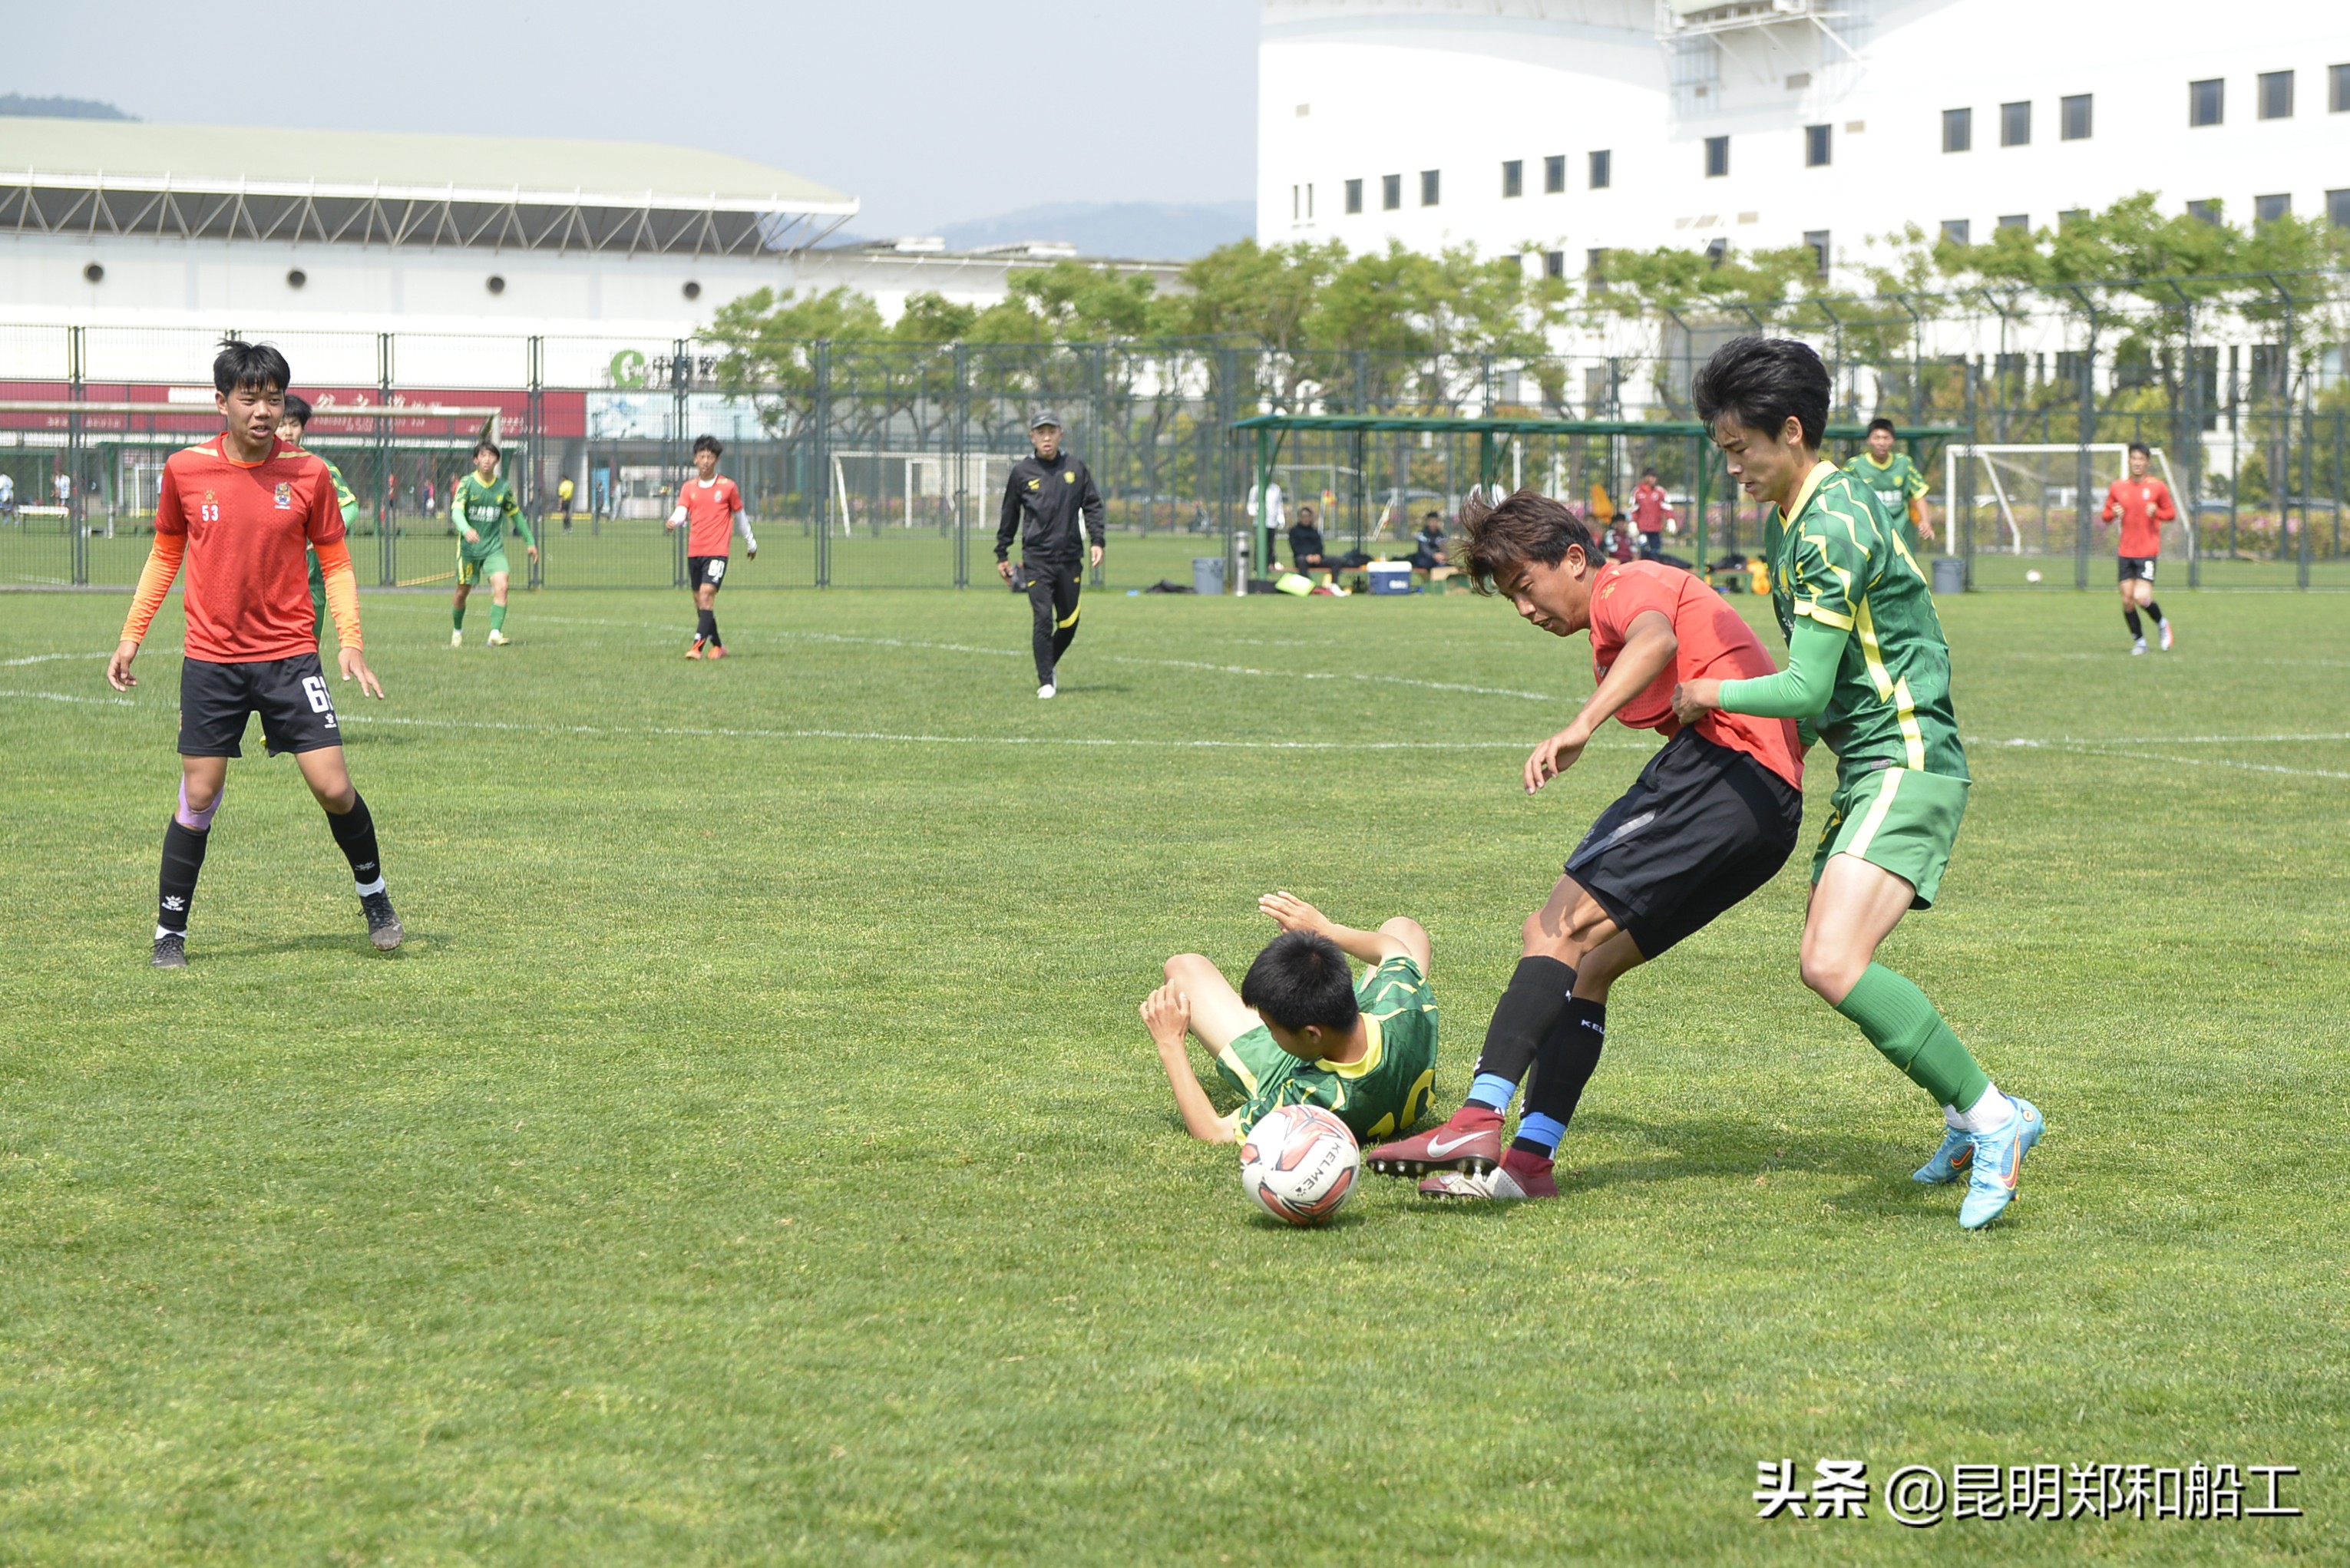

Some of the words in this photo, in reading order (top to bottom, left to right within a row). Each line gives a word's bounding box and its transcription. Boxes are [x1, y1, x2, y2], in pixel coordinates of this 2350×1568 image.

[201, 504, 219, 521] 53
[1581, 1018, 1606, 1035] KEL
[1303, 1142, 1342, 1190] KELME
